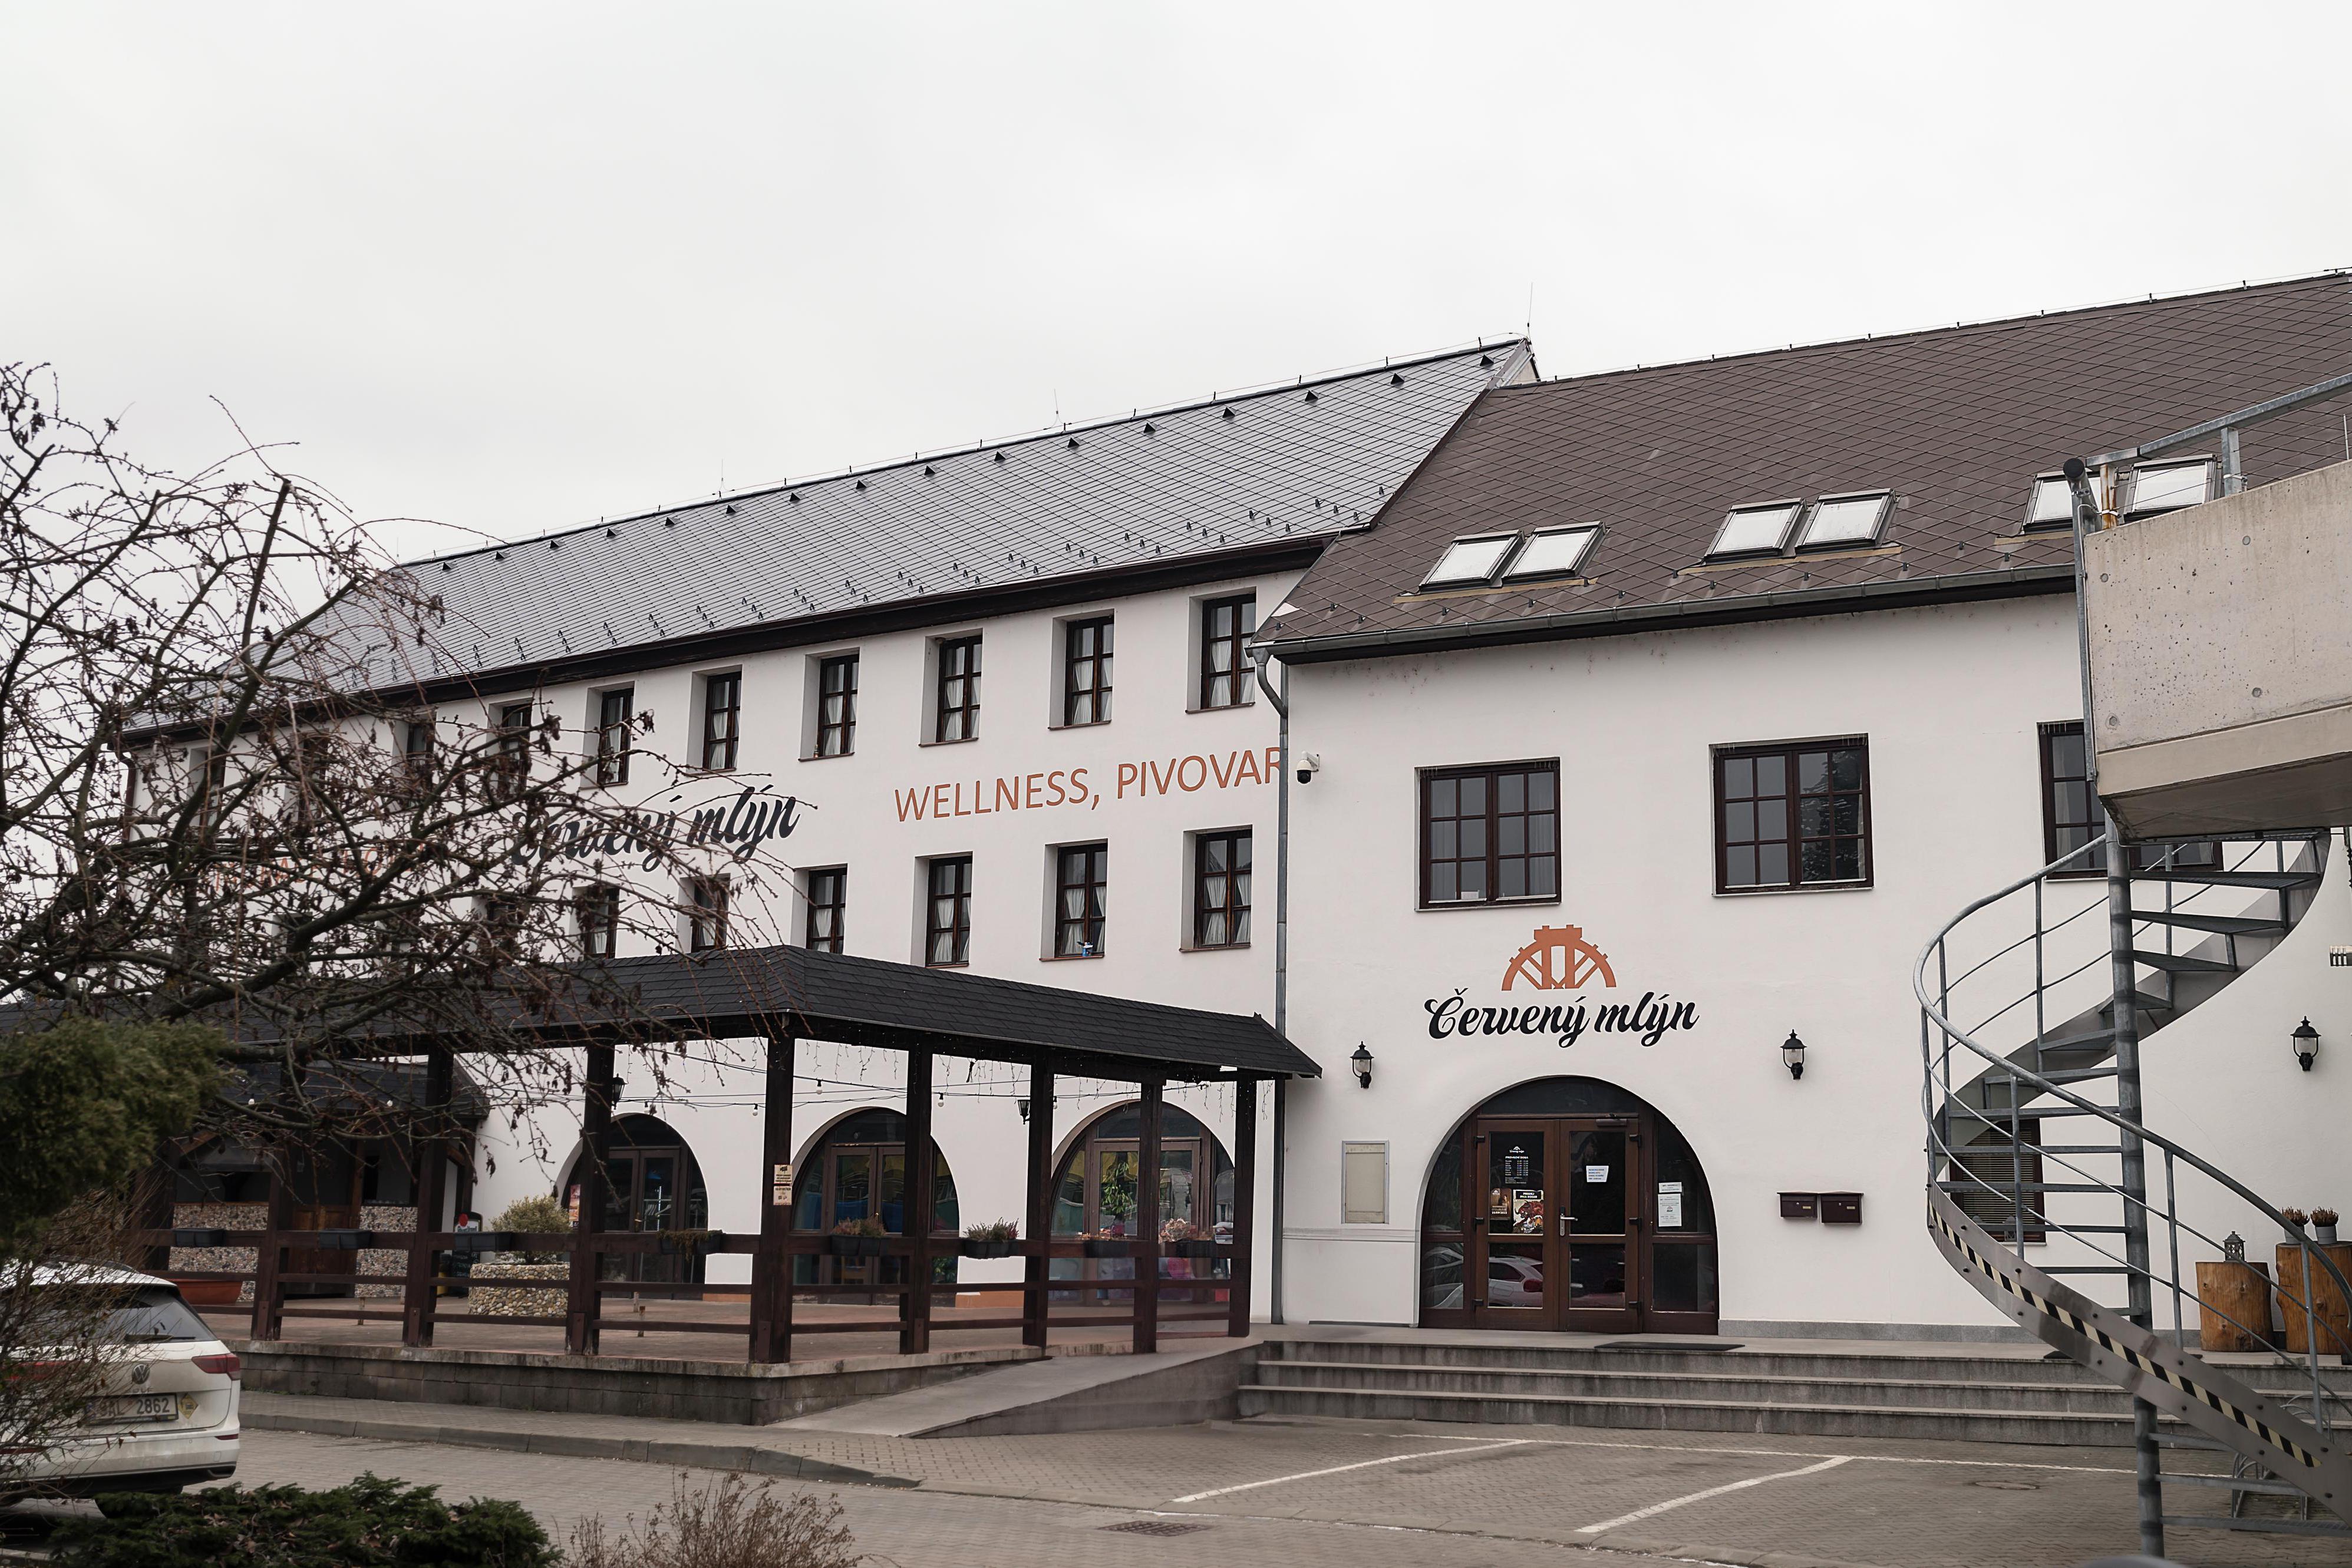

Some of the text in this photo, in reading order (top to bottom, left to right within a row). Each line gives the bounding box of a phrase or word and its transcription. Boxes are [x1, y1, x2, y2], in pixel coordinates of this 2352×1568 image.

[895, 747, 1281, 823] WELLNESS, PIVOVAR
[687, 784, 801, 863] mlýn
[1424, 987, 1700, 1048] Červený mlýn
[136, 1397, 170, 1415] 2862
